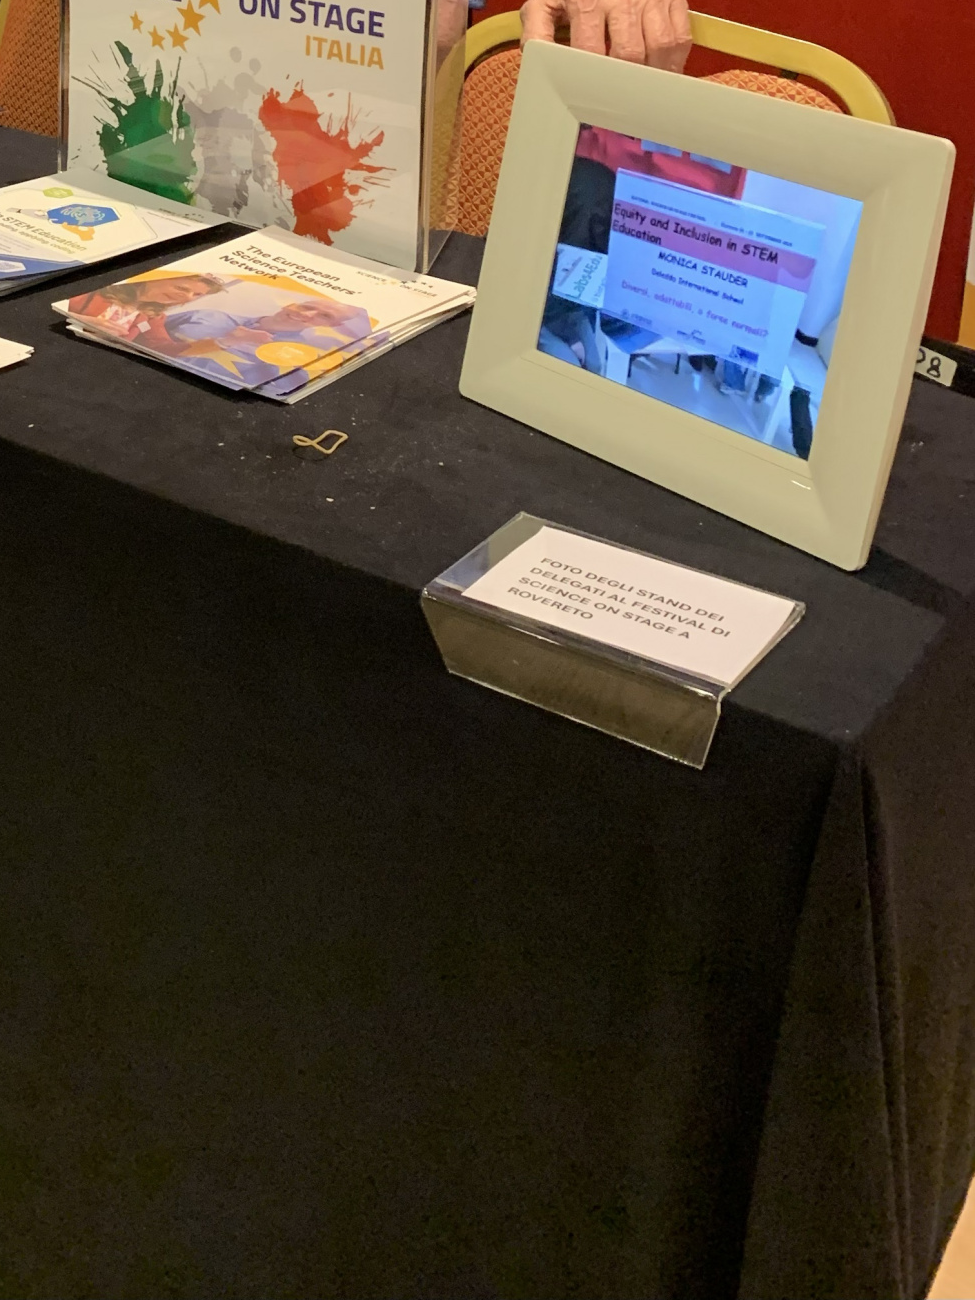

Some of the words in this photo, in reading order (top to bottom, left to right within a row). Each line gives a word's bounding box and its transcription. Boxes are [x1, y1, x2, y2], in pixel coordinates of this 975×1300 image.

[304, 34, 384, 70] ITALIA
[2, 216, 35, 230] STEM
[31, 228, 87, 251] Education
[612, 221, 662, 246] Education
[613, 203, 646, 225] Equity
[650, 215, 669, 231] and
[672, 218, 722, 247] Inclusion
[726, 236, 737, 251] in
[741, 243, 778, 264] STEM
[219, 255, 279, 280] Network
[231, 250, 287, 274] Science
[246, 245, 272, 260] The
[274, 255, 341, 282] European
[657, 251, 697, 271] MONICA
[701, 265, 748, 289] STAUDER
[678, 277, 719, 297] International
[722, 292, 744, 305] School
[507, 586, 593, 620] ROVERETO
[518, 576, 592, 605] SCIENCE
[594, 601, 620, 615] ON
[622, 611, 677, 634] STAGE
[678, 630, 691, 639] A
[529, 567, 607, 597] DELEGATI
[607, 594, 627, 604] AL
[631, 601, 706, 631] FESTIVAL
[711, 625, 731, 638] DI
[540, 557, 582, 575] FOTO
[585, 572, 634, 593] DEGLI
[636, 589, 691, 612] STAND
[694, 608, 725, 622] DEI
